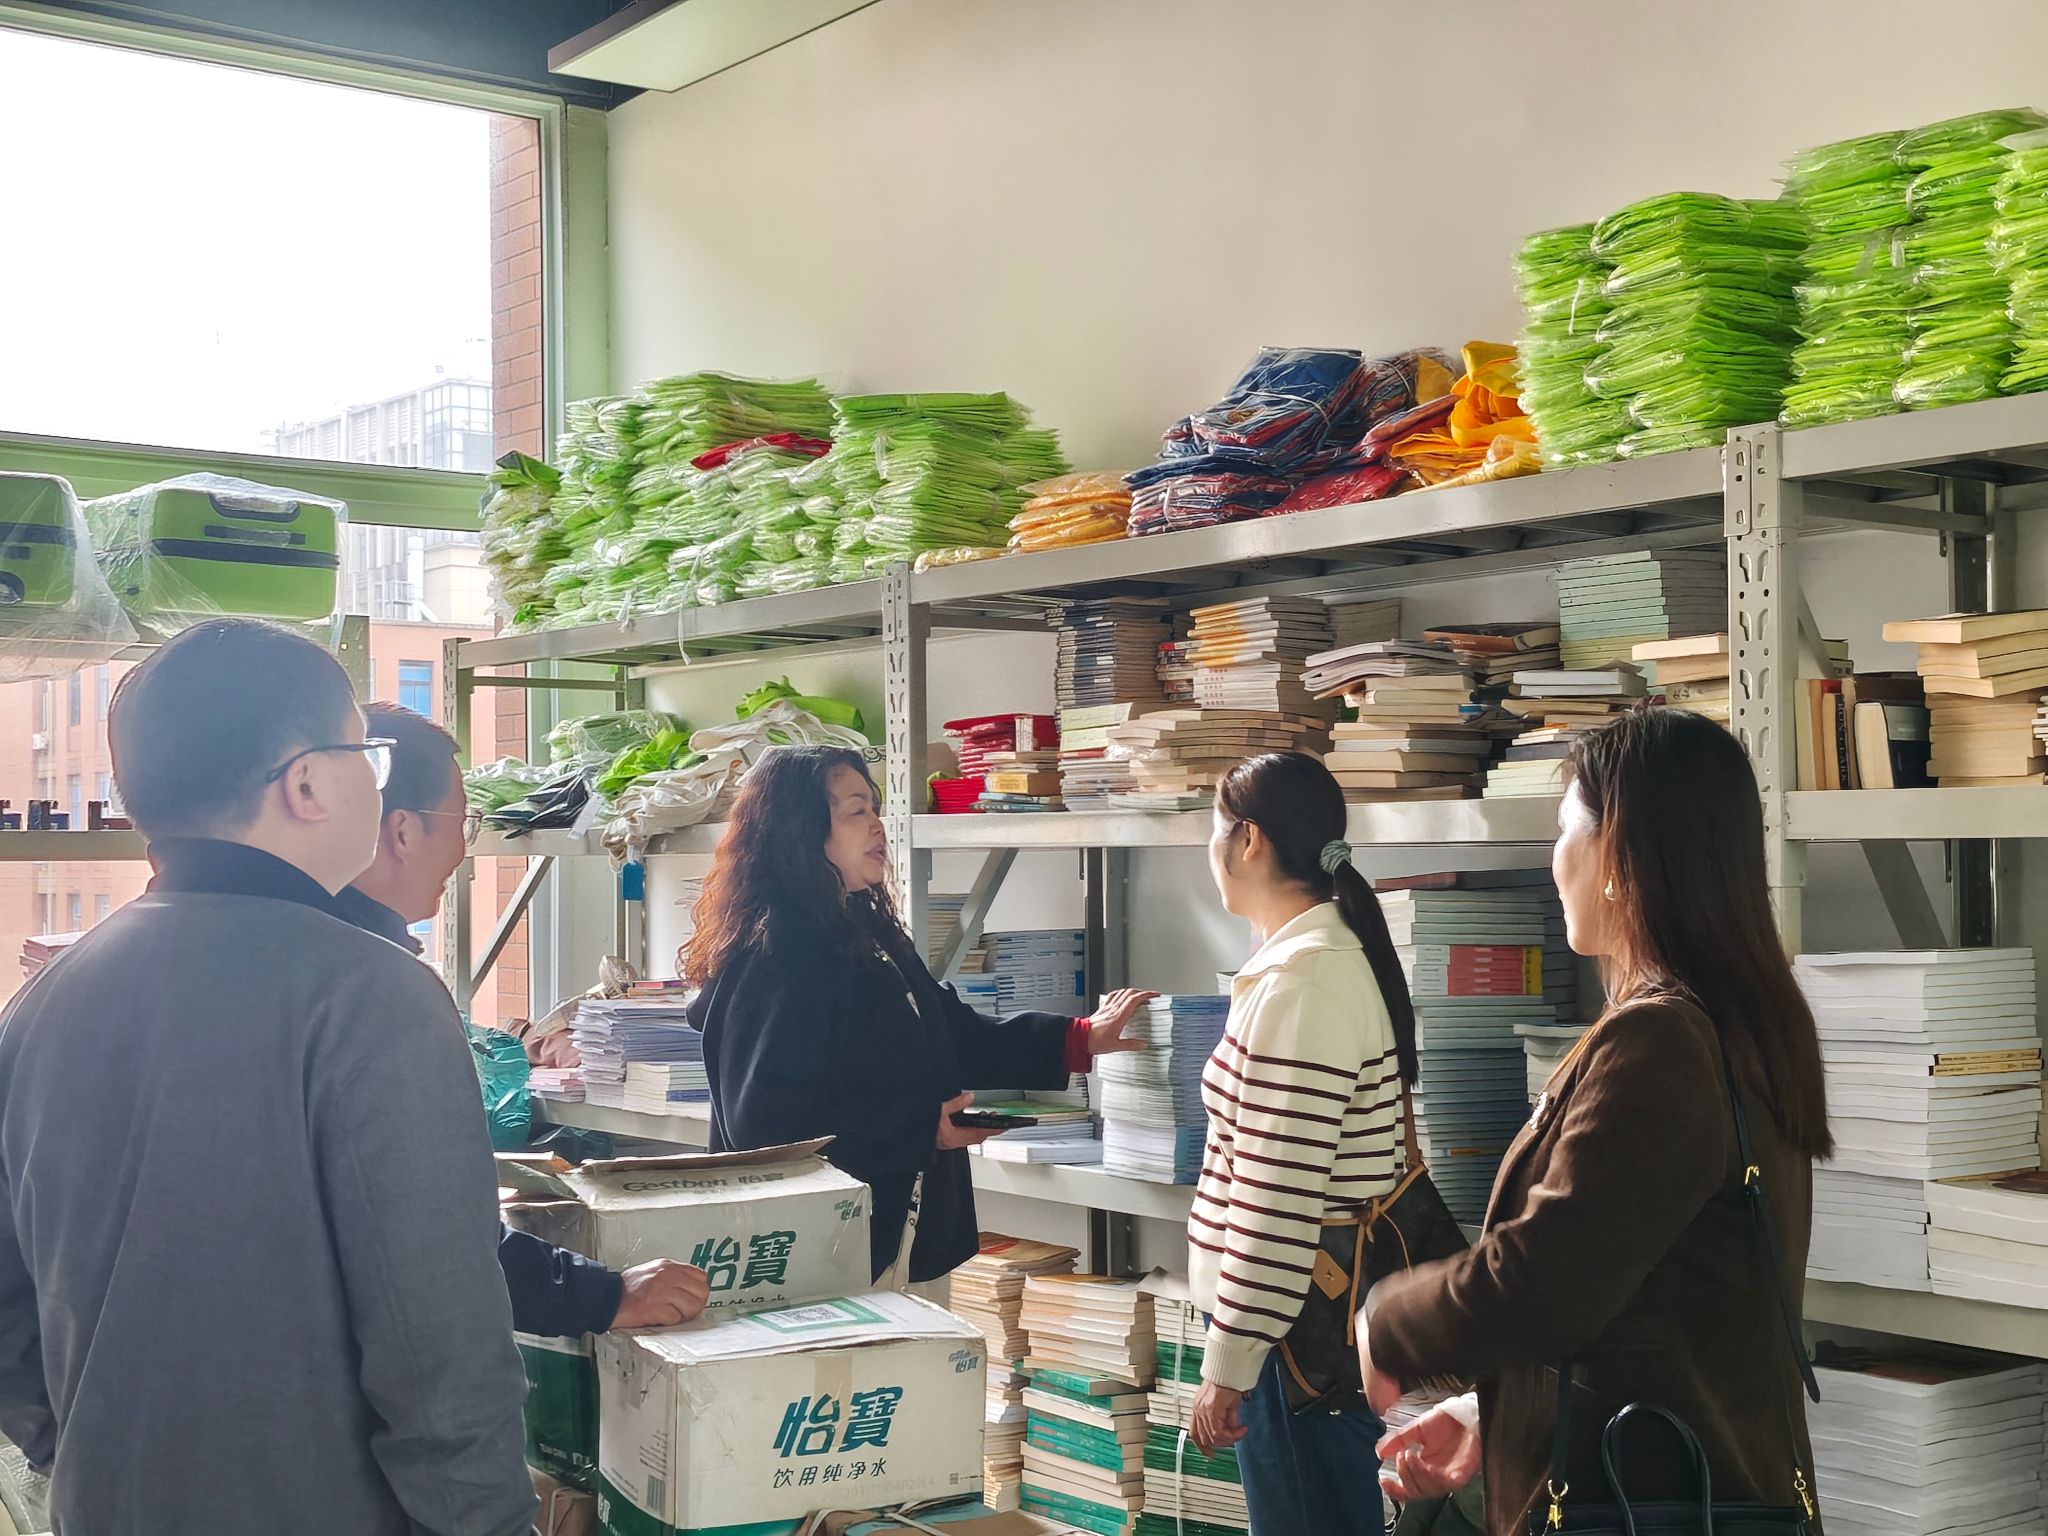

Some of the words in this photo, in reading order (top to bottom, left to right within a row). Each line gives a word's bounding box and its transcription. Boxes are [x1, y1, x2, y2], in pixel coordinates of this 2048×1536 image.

[773, 1458, 888, 1489] 饮用纯净水
